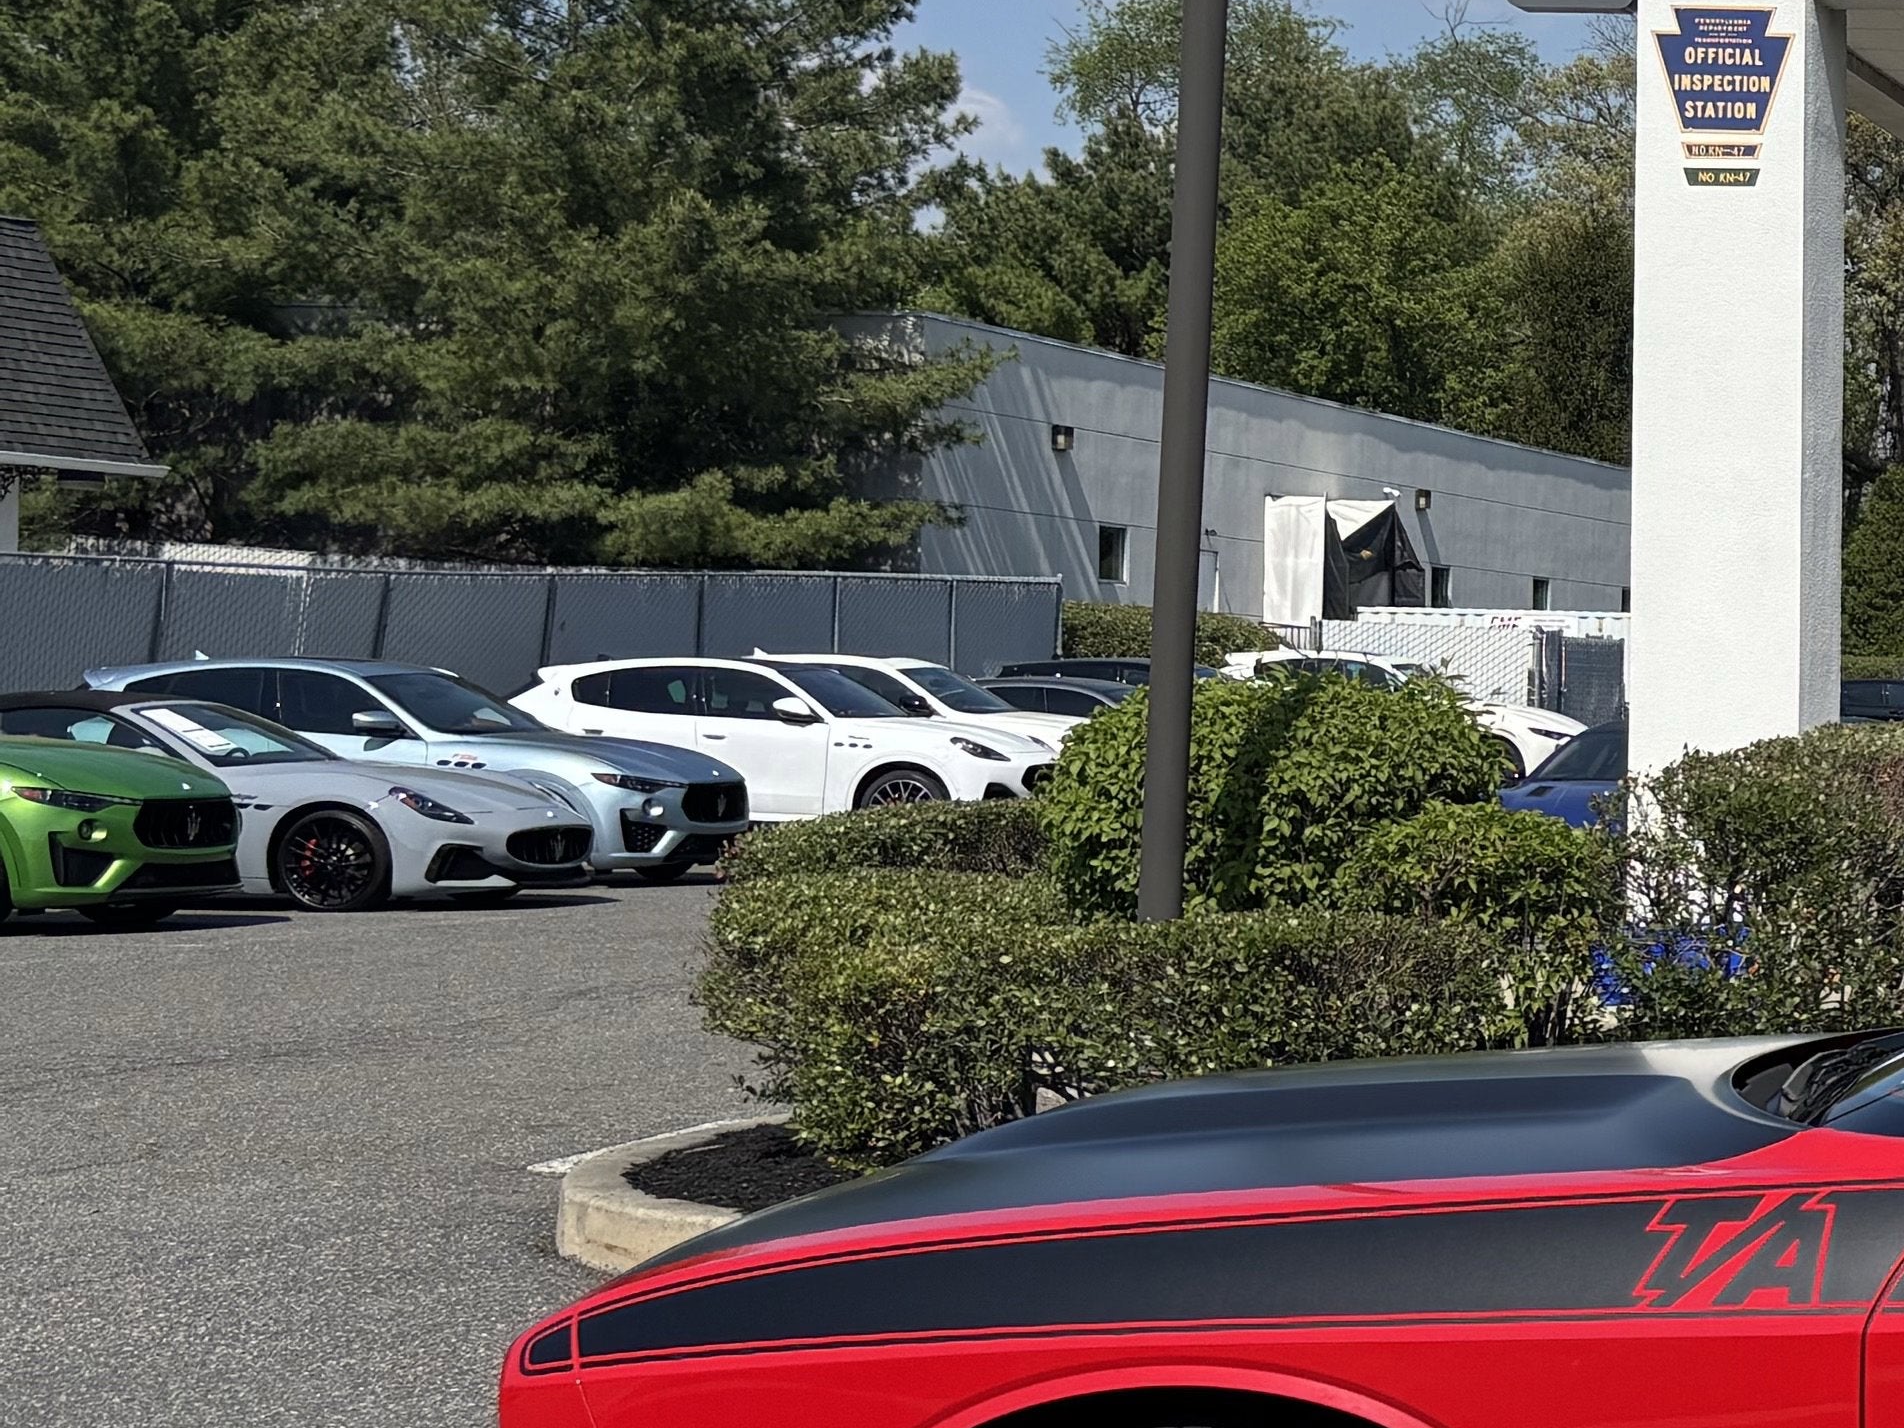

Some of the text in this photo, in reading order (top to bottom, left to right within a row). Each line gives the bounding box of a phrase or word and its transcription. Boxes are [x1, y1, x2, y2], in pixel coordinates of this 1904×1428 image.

[1684, 46, 1764, 66] OFFICIAL
[1673, 74, 1771, 93] INSPECTION
[1684, 100, 1757, 119] STATION
[1632, 1190, 1837, 1308] T/A
